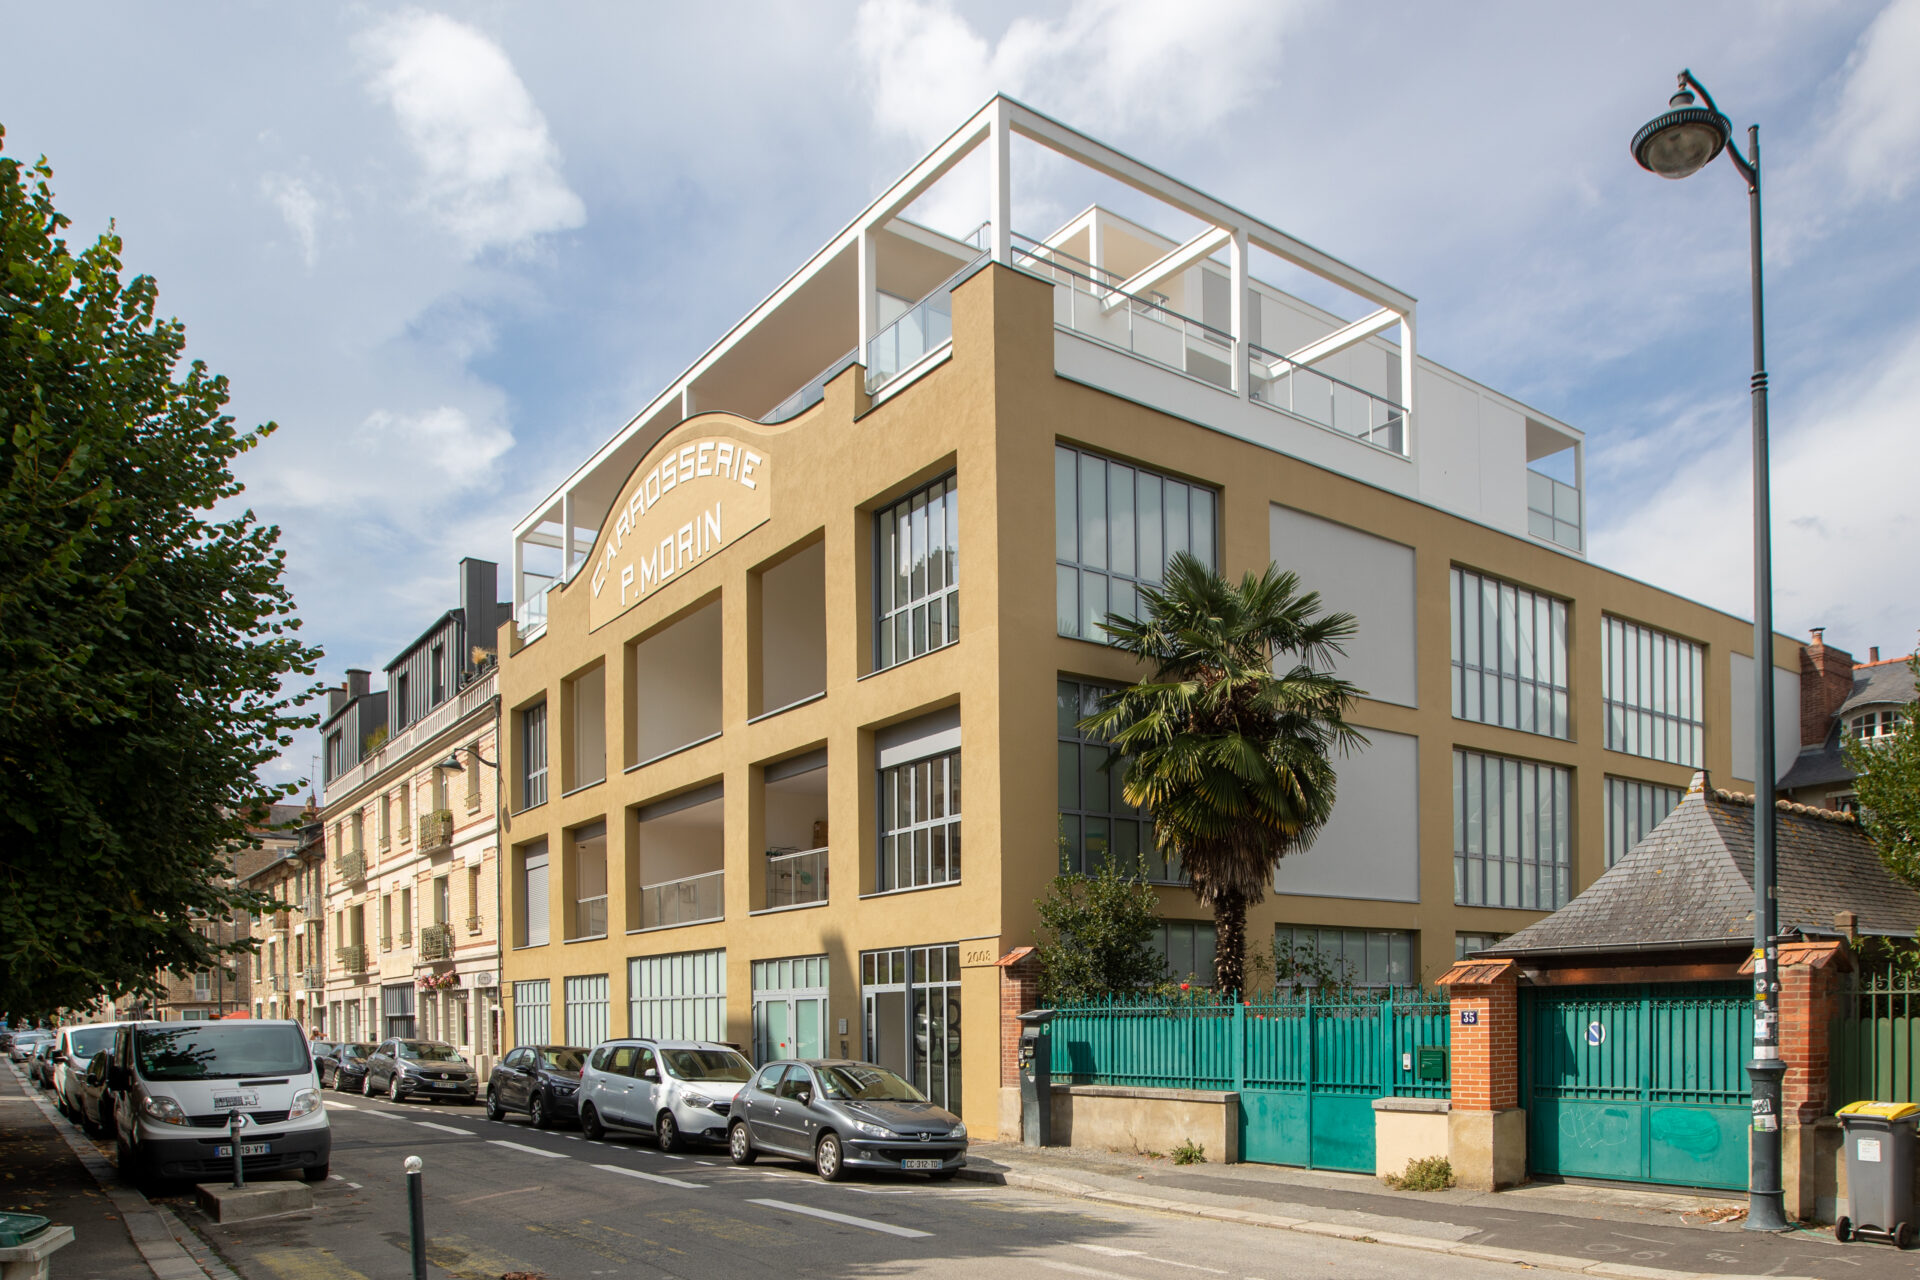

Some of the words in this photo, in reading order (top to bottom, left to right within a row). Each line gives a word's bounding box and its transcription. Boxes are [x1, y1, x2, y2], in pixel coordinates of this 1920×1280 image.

[592, 442, 762, 598] CARROSSERIE
[621, 501, 722, 606] P.MORIN
[967, 950, 991, 963] 2008
[1463, 1012, 1475, 1023] 35
[220, 1145, 264, 1156] CL19-VY
